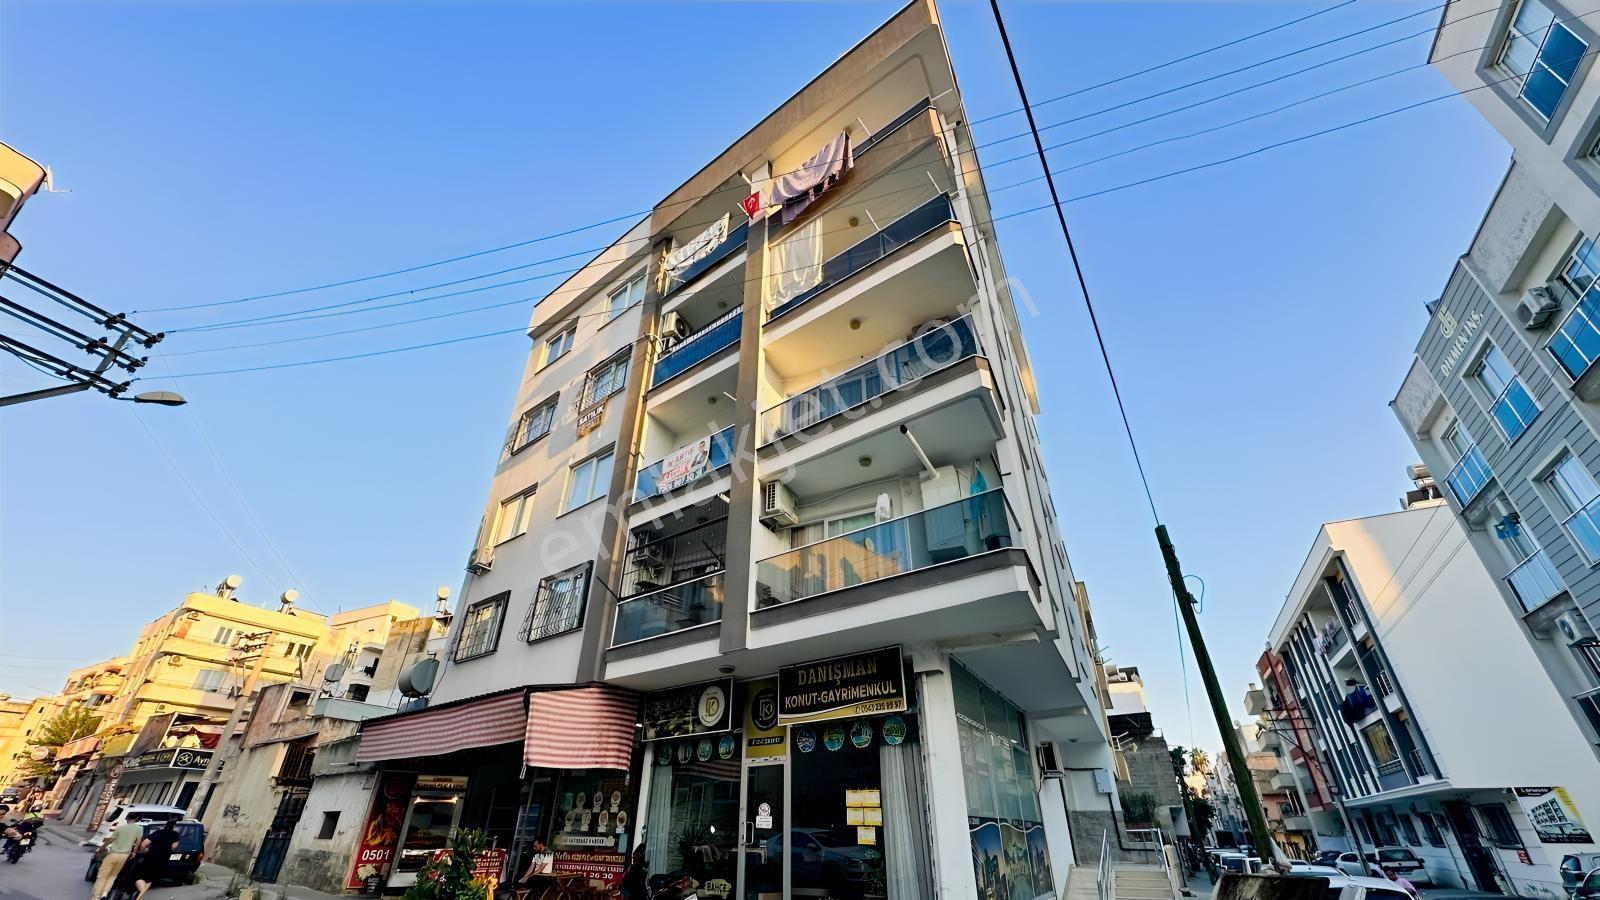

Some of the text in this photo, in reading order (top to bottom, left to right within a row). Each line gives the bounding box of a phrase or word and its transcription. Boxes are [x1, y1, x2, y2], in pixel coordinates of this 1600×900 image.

[797, 657, 878, 686] DANIŞMAN
[785, 680, 897, 709] KONUT-GAYRİMENKUL
[362, 848, 390, 861] 0501
